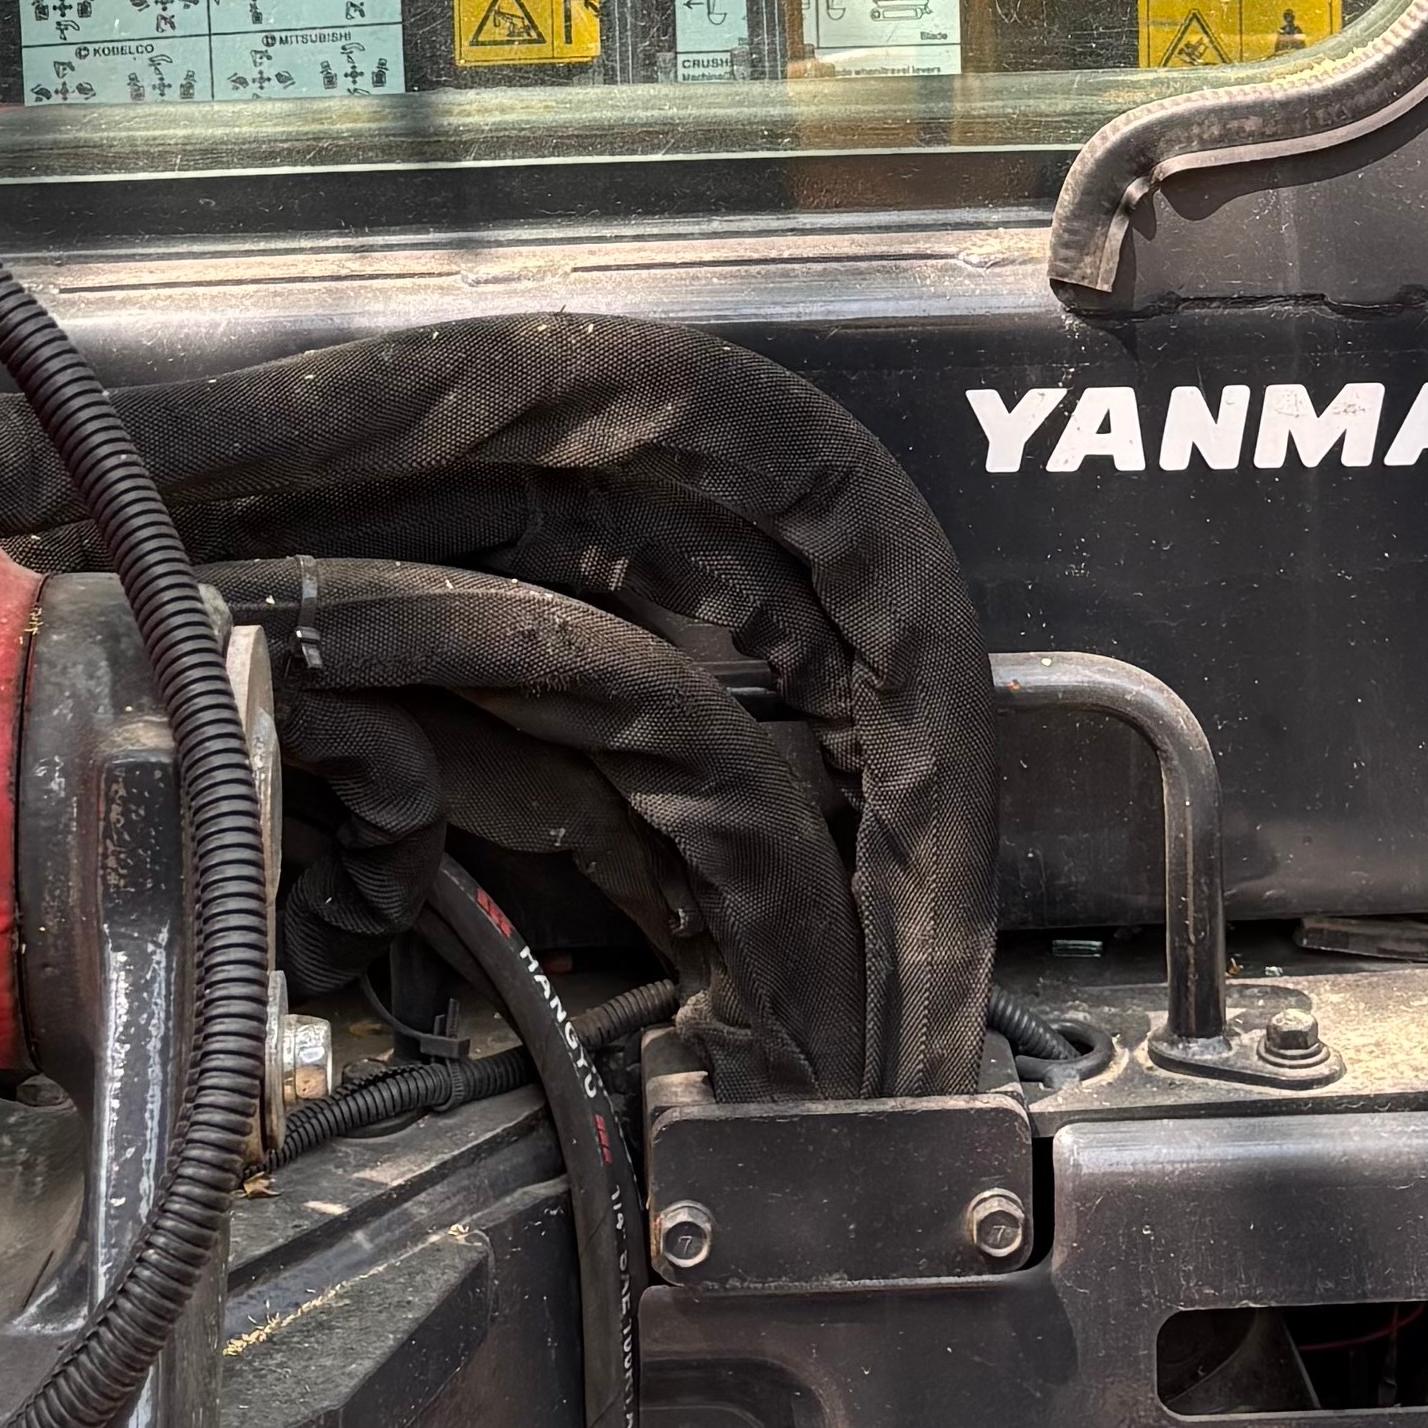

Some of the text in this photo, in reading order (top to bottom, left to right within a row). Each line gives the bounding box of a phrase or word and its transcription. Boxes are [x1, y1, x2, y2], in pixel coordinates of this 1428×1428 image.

[278, 30, 351, 45] MITSUBISHI
[92, 44, 154, 58] KOBELCO
[682, 58, 730, 69] CRUSH
[993, 1225, 1007, 1242] 7
[677, 1235, 693, 1254] 7
